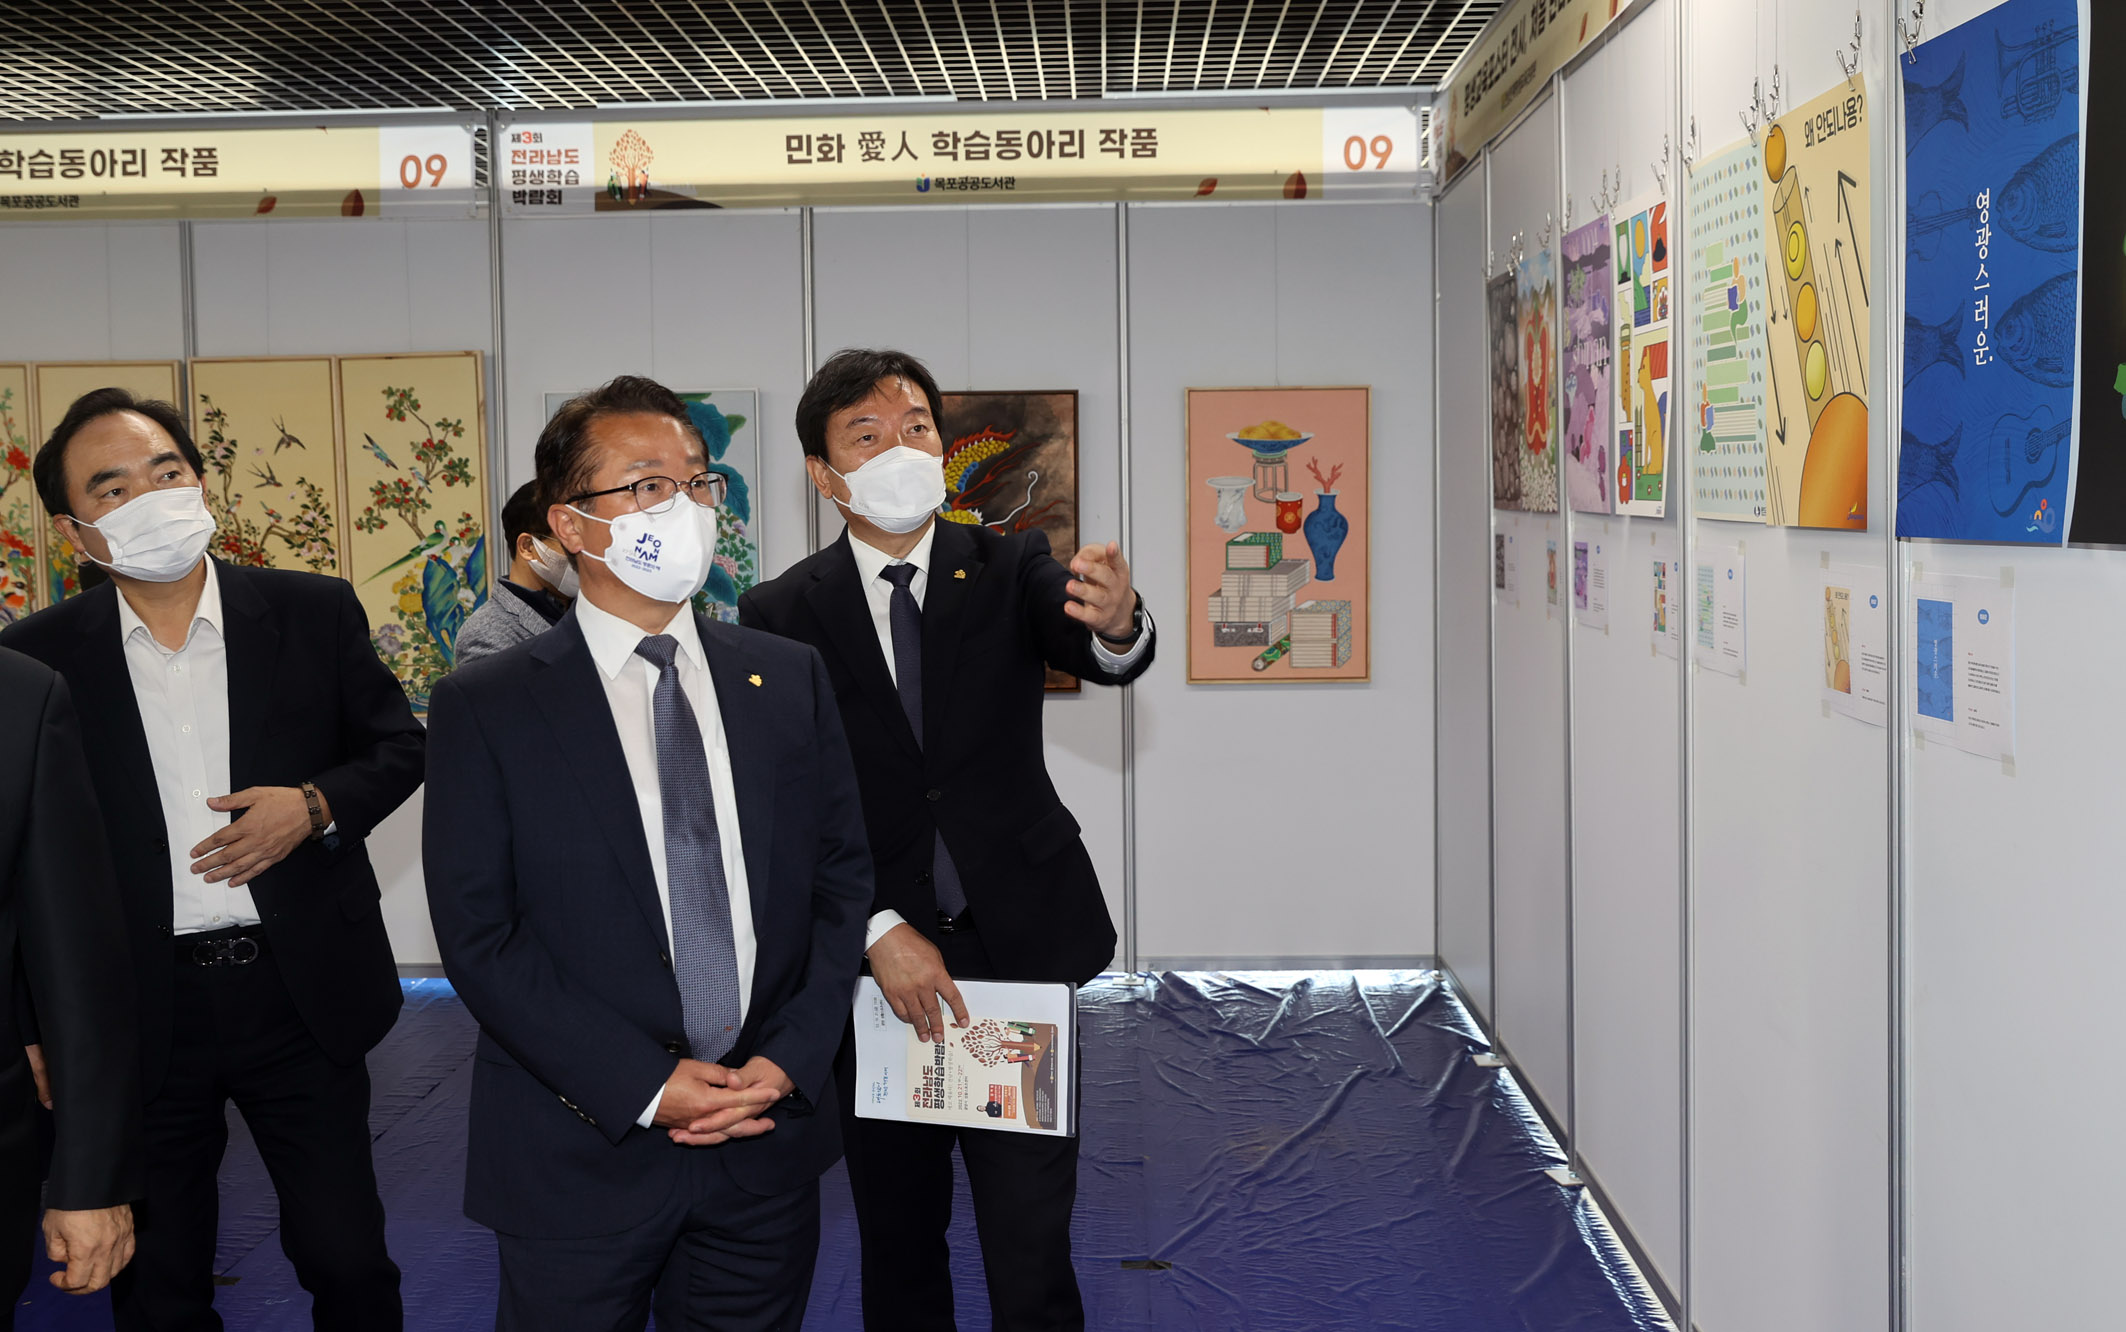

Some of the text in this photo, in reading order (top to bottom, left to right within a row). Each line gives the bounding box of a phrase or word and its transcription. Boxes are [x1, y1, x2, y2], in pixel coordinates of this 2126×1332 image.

[511, 131, 543, 144] 제3회
[1804, 94, 1863, 148] 왜 안되나용?
[511, 149, 580, 165] 전라남도
[785, 127, 1159, 164] 민화 愛人 학습동아리 작품
[1343, 135, 1393, 170] 09
[0, 147, 219, 180] 학습동아리 작품
[400, 154, 447, 188] 09
[511, 169, 579, 185] 평생학습
[512, 188, 563, 205] 박람회
[935, 176, 1016, 191] 목포공공도서관
[1973, 187, 1993, 366] 영광스러운.
[922, 1065, 933, 1109] 전라남도
[934, 1038, 945, 1109] 평생학습박람
[912, 1087, 921, 1108] 제3회
